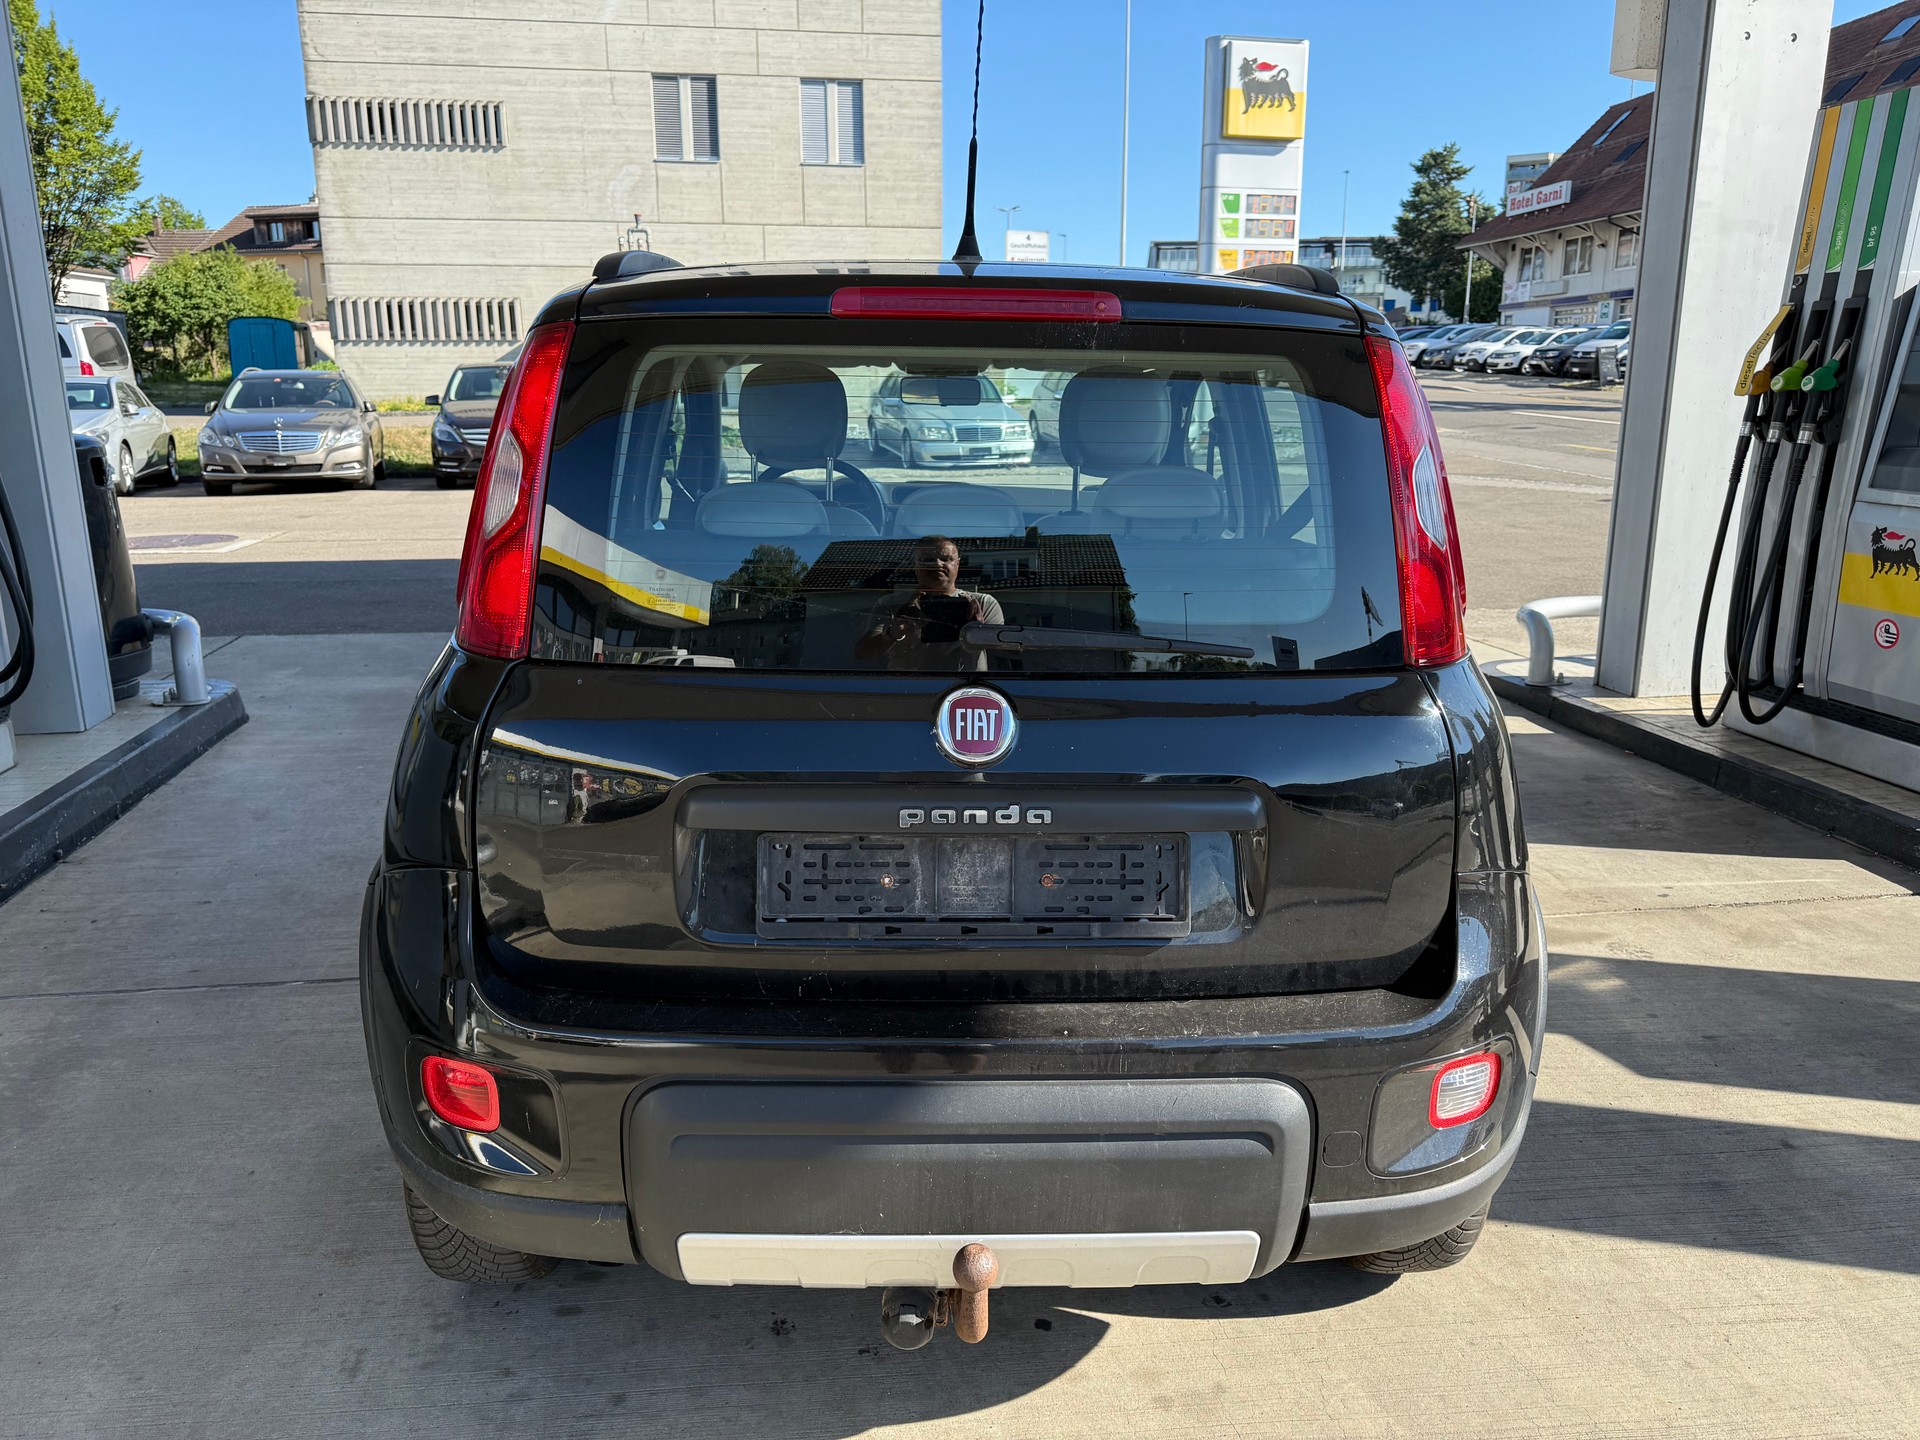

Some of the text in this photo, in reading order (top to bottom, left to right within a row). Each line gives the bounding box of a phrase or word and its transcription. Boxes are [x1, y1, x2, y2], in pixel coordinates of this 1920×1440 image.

[1509, 185, 1563, 211] Hotel Garni
[1802, 231, 1813, 253] diesel
[1867, 238, 1875, 248] bf
[1739, 360, 1753, 389] diesel
[954, 707, 1000, 741] FIAT
[898, 803, 1053, 828] panda
